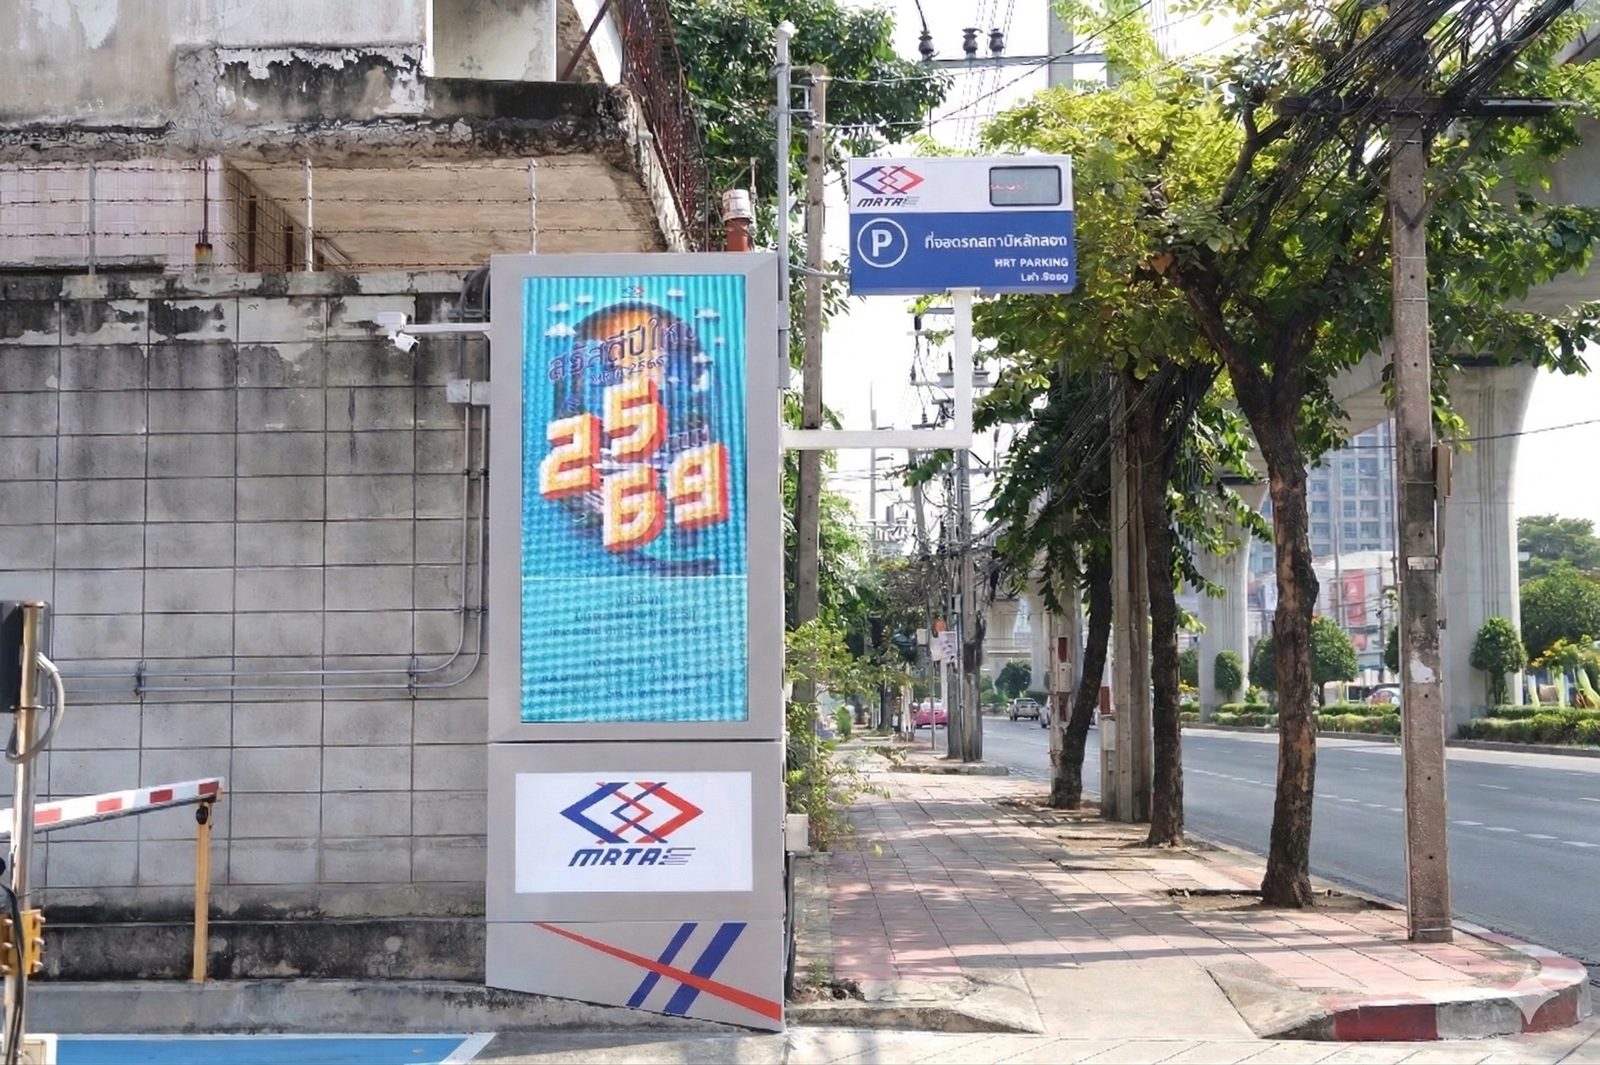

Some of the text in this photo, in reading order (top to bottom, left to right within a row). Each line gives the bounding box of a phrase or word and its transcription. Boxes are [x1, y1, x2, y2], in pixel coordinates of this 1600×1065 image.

[872, 229, 892, 257] P
[1020, 257, 1069, 267] PARKING
[567, 847, 664, 868] MRTA
